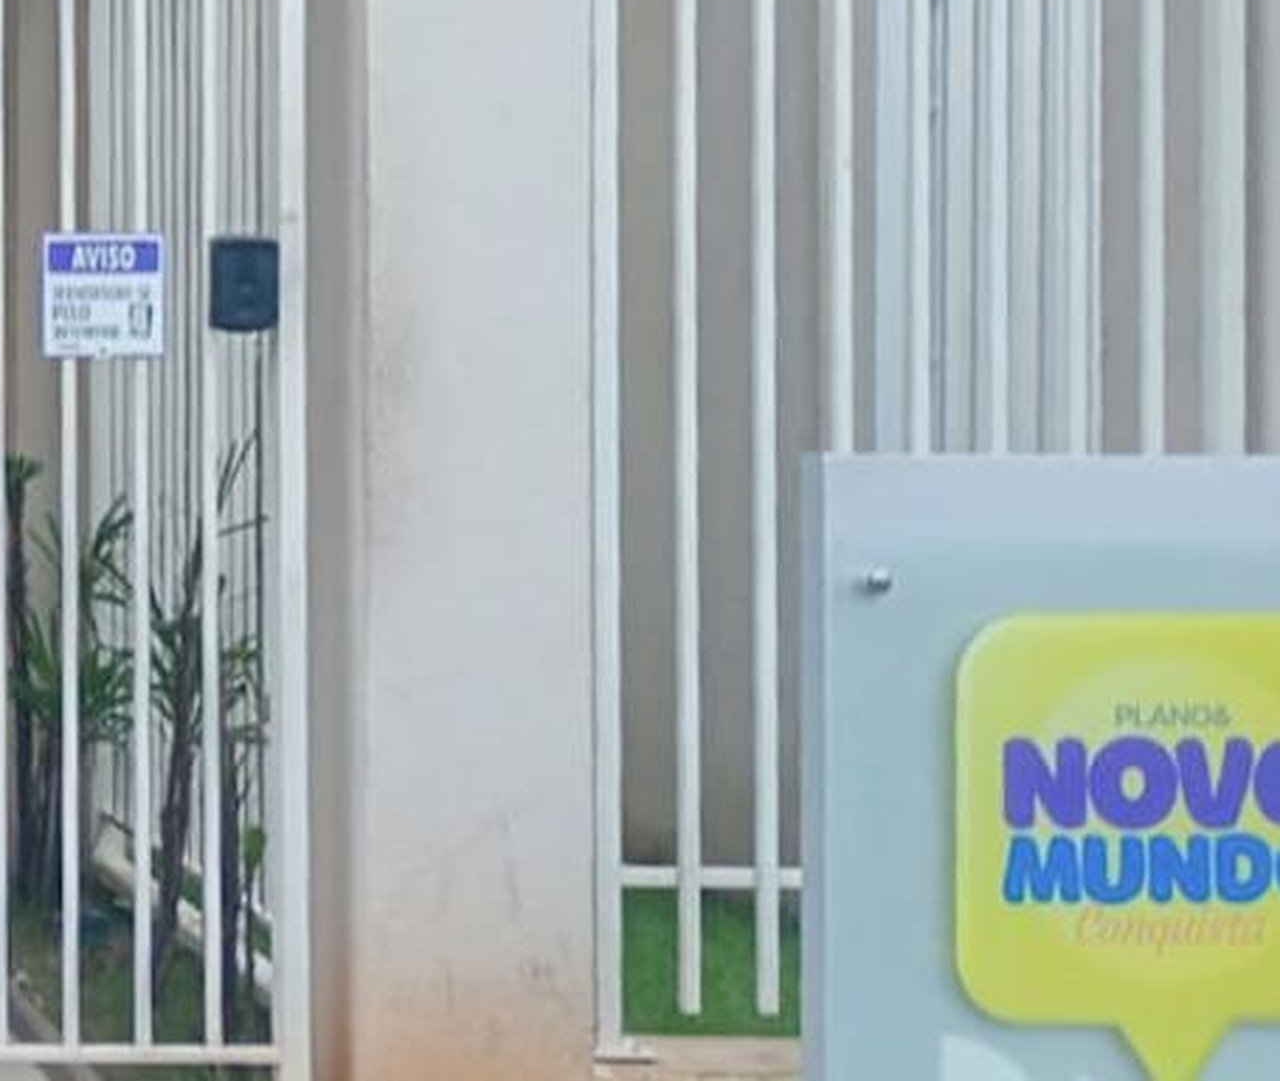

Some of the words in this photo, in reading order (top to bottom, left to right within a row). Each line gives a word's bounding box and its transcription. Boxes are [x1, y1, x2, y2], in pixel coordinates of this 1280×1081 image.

[71, 245, 137, 269] AVISO
[1003, 736, 1280, 829] NOV
[1003, 833, 1280, 904] MUND
